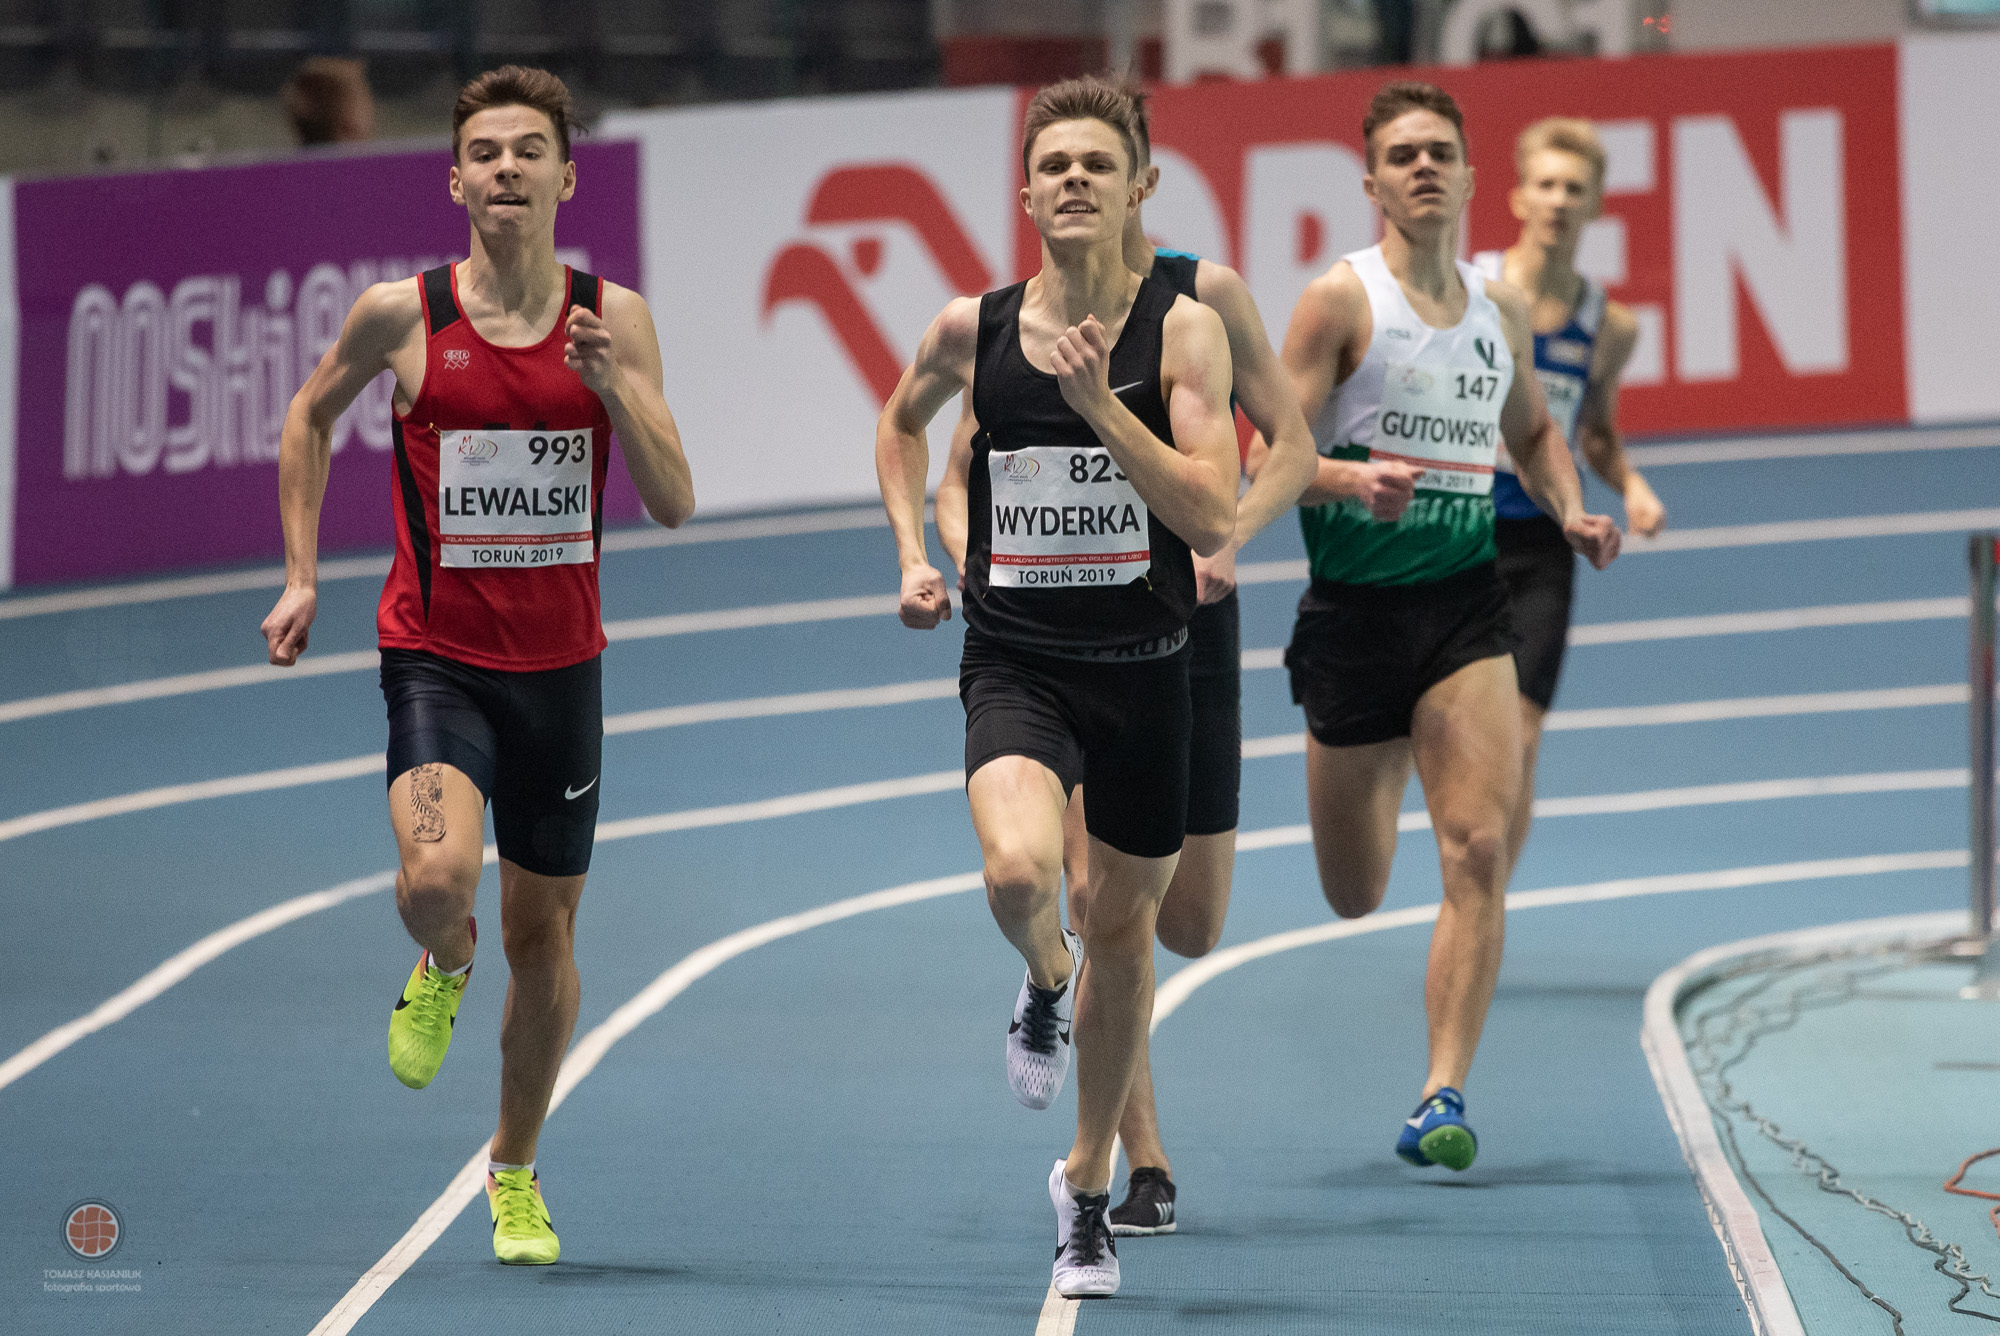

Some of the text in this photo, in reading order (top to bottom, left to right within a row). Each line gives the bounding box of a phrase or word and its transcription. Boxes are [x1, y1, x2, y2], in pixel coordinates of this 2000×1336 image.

[1455, 374, 1498, 401] 147
[1382, 411, 1495, 449] GUTOWSKI
[528, 434, 586, 465] 993
[445, 484, 587, 516] LEWALSKI
[995, 503, 1141, 536] WYDERKA
[472, 546, 564, 563] TORUŃ 2019
[1018, 565, 1116, 584] TORUŃ 2019
